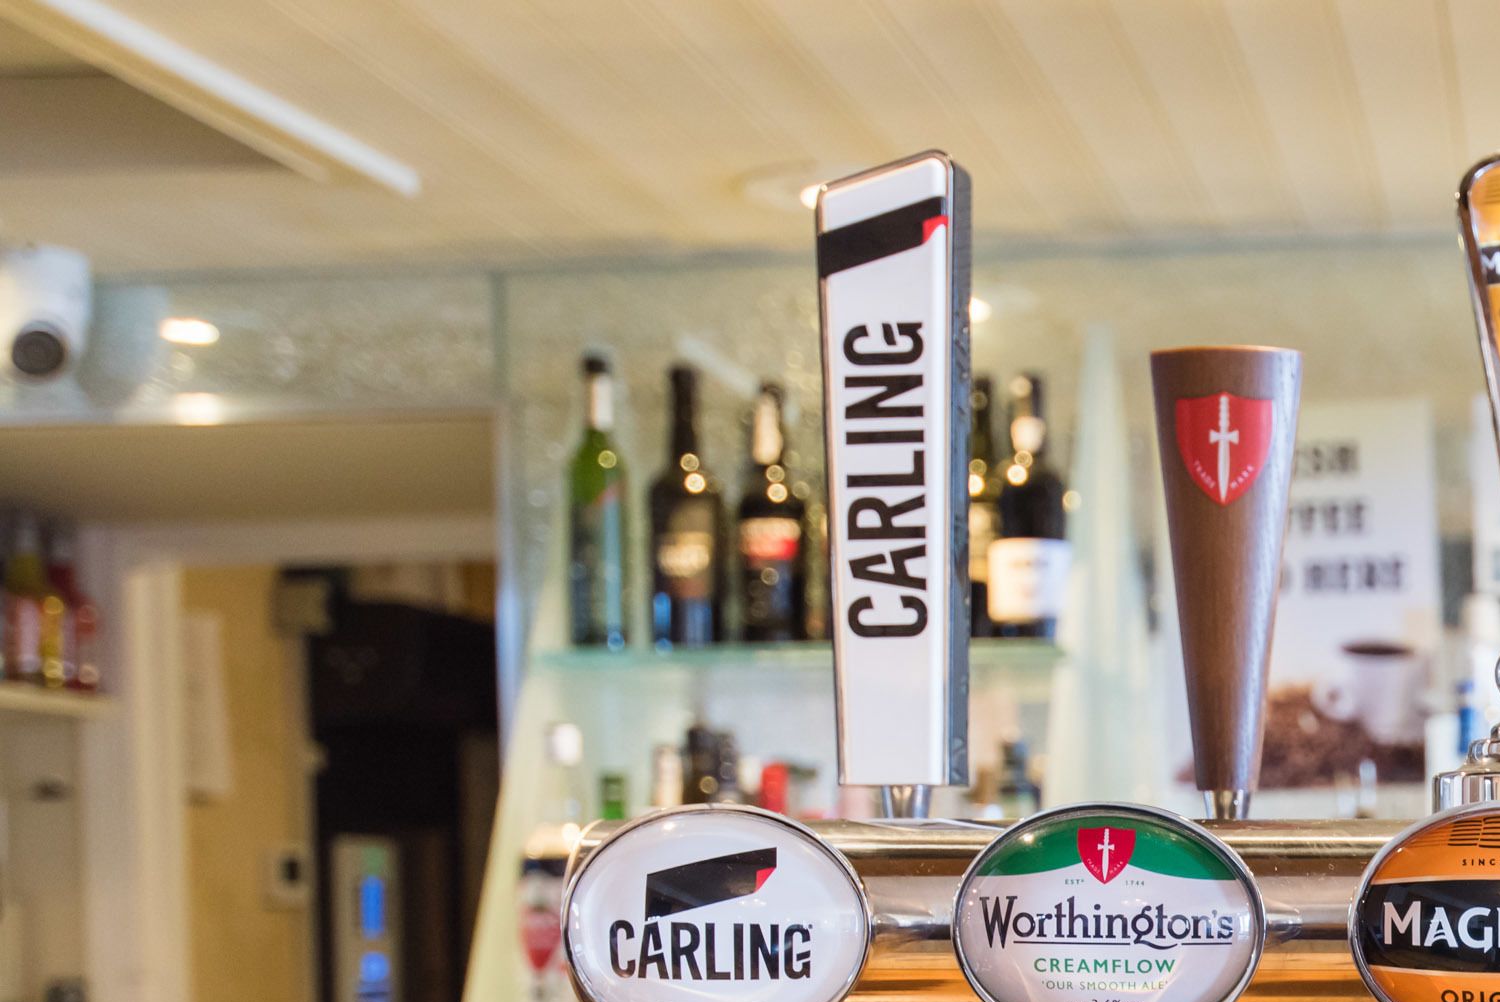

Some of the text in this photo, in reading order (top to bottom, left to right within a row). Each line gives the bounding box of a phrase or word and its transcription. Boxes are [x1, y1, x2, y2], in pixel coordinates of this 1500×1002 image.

[843, 321, 928, 638] CARLING
[980, 895, 1233, 949] Worthington's
[609, 919, 812, 980] CARLING
[1034, 958, 1176, 974] CREAMFLOW
[1079, 981, 1137, 990] SMOOTH
